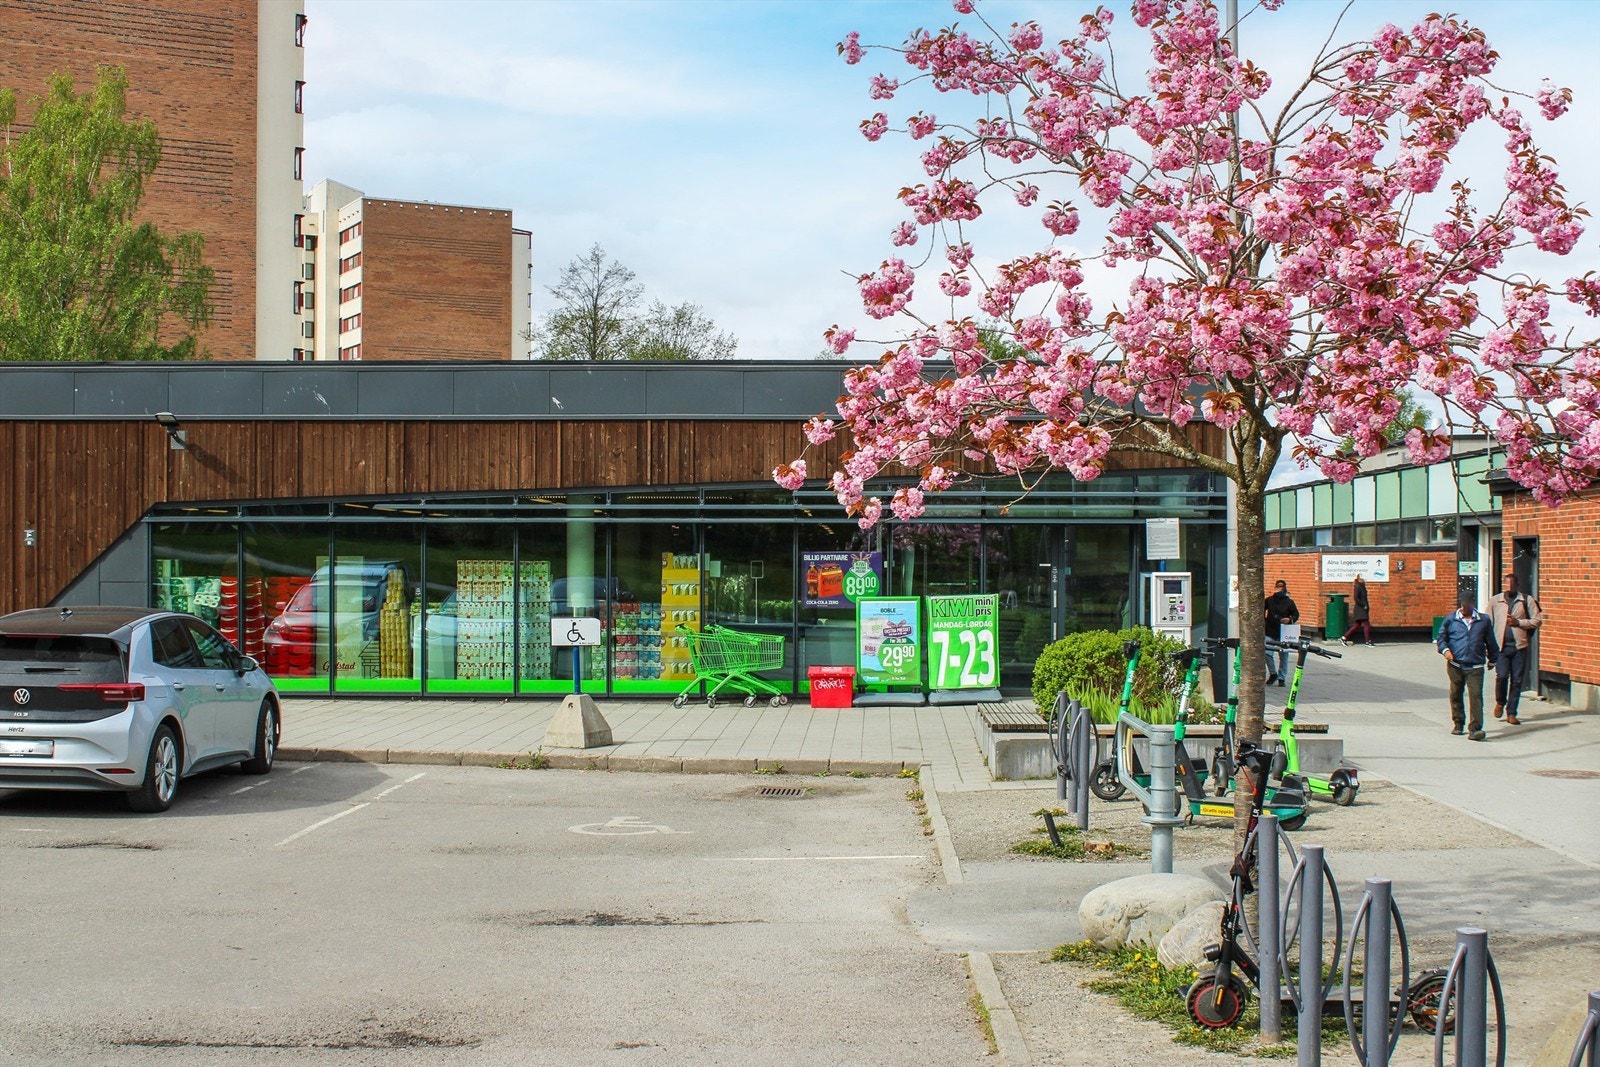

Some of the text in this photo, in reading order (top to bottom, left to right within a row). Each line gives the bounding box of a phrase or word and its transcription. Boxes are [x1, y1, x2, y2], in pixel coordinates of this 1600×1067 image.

[931, 597, 994, 618] KIWI mini
[975, 606, 992, 617] pris
[933, 621, 993, 629] MANDAG-LØRDAG
[932, 629, 996, 687] 7-23
[1252, 808, 1260, 818] LR
